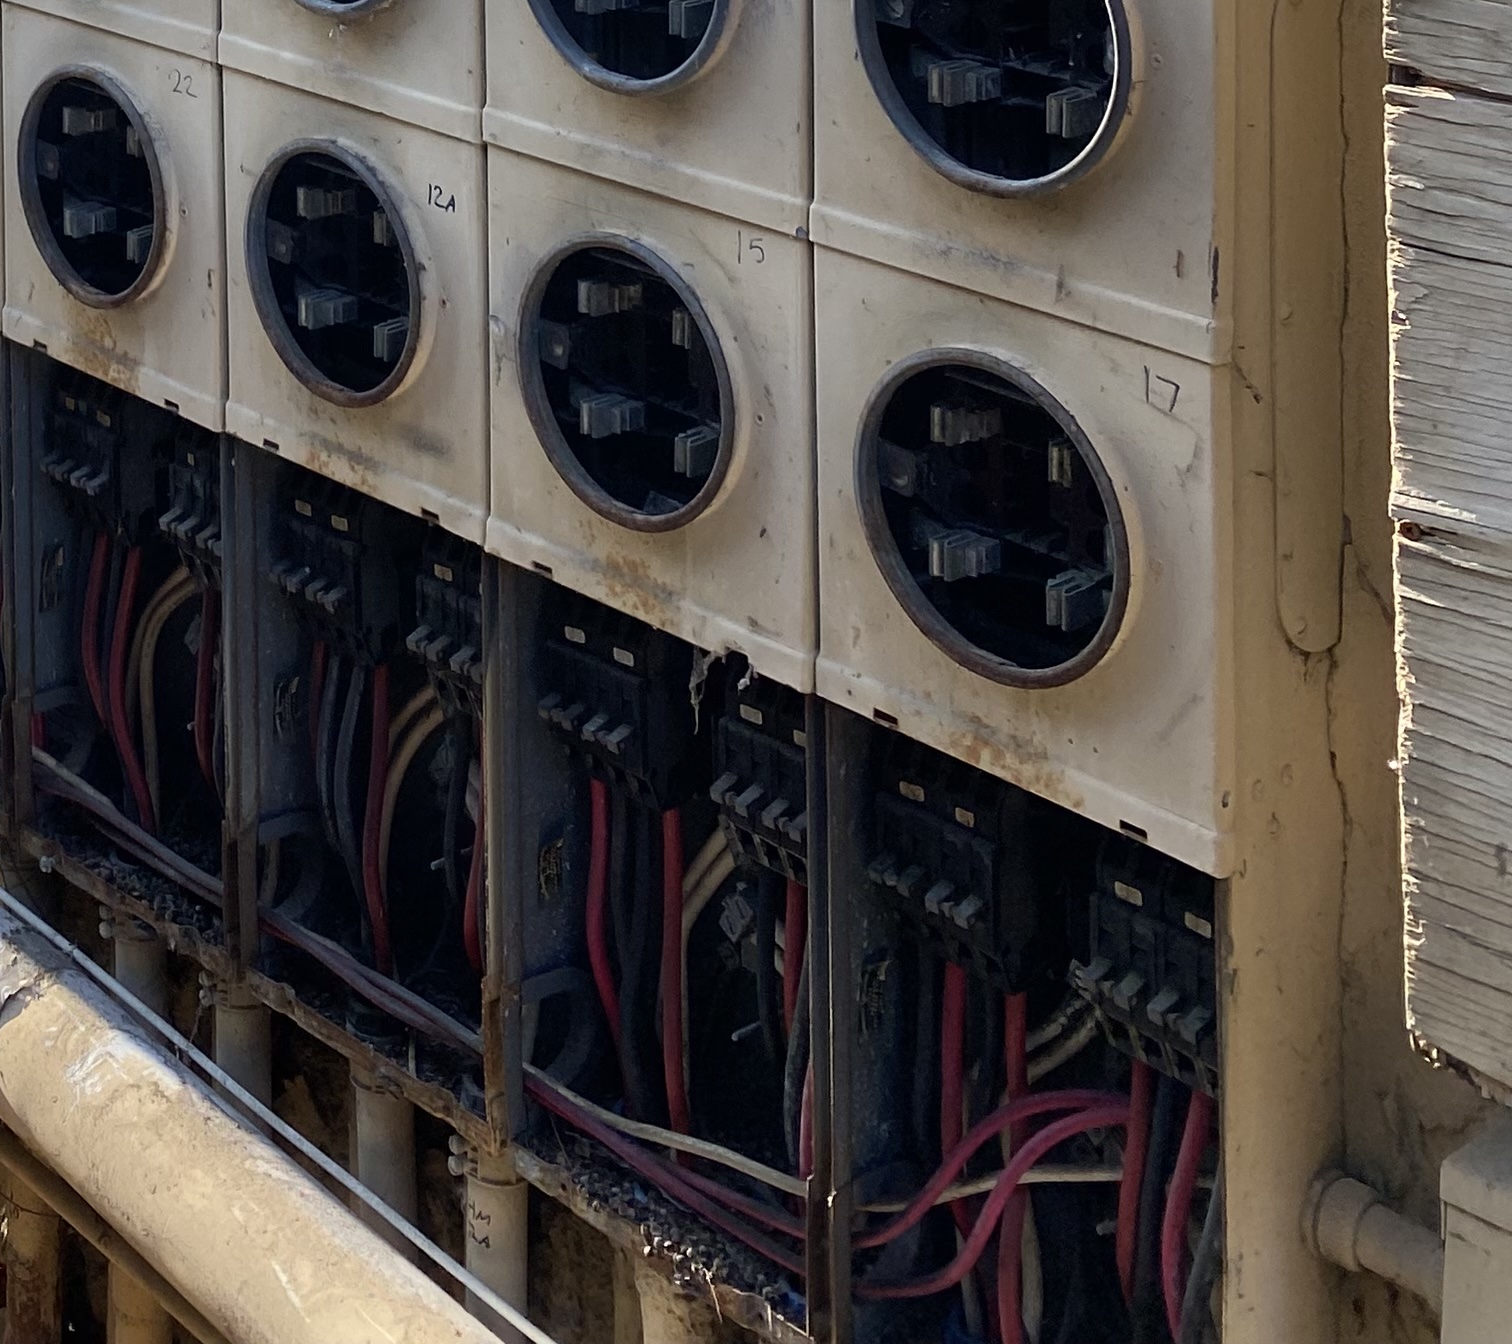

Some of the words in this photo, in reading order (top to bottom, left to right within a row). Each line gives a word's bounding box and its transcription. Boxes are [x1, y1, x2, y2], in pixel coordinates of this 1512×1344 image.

[168, 68, 198, 99] 22
[428, 183, 456, 212] 12A
[737, 230, 766, 264] 15
[1144, 365, 1180, 413] 17
